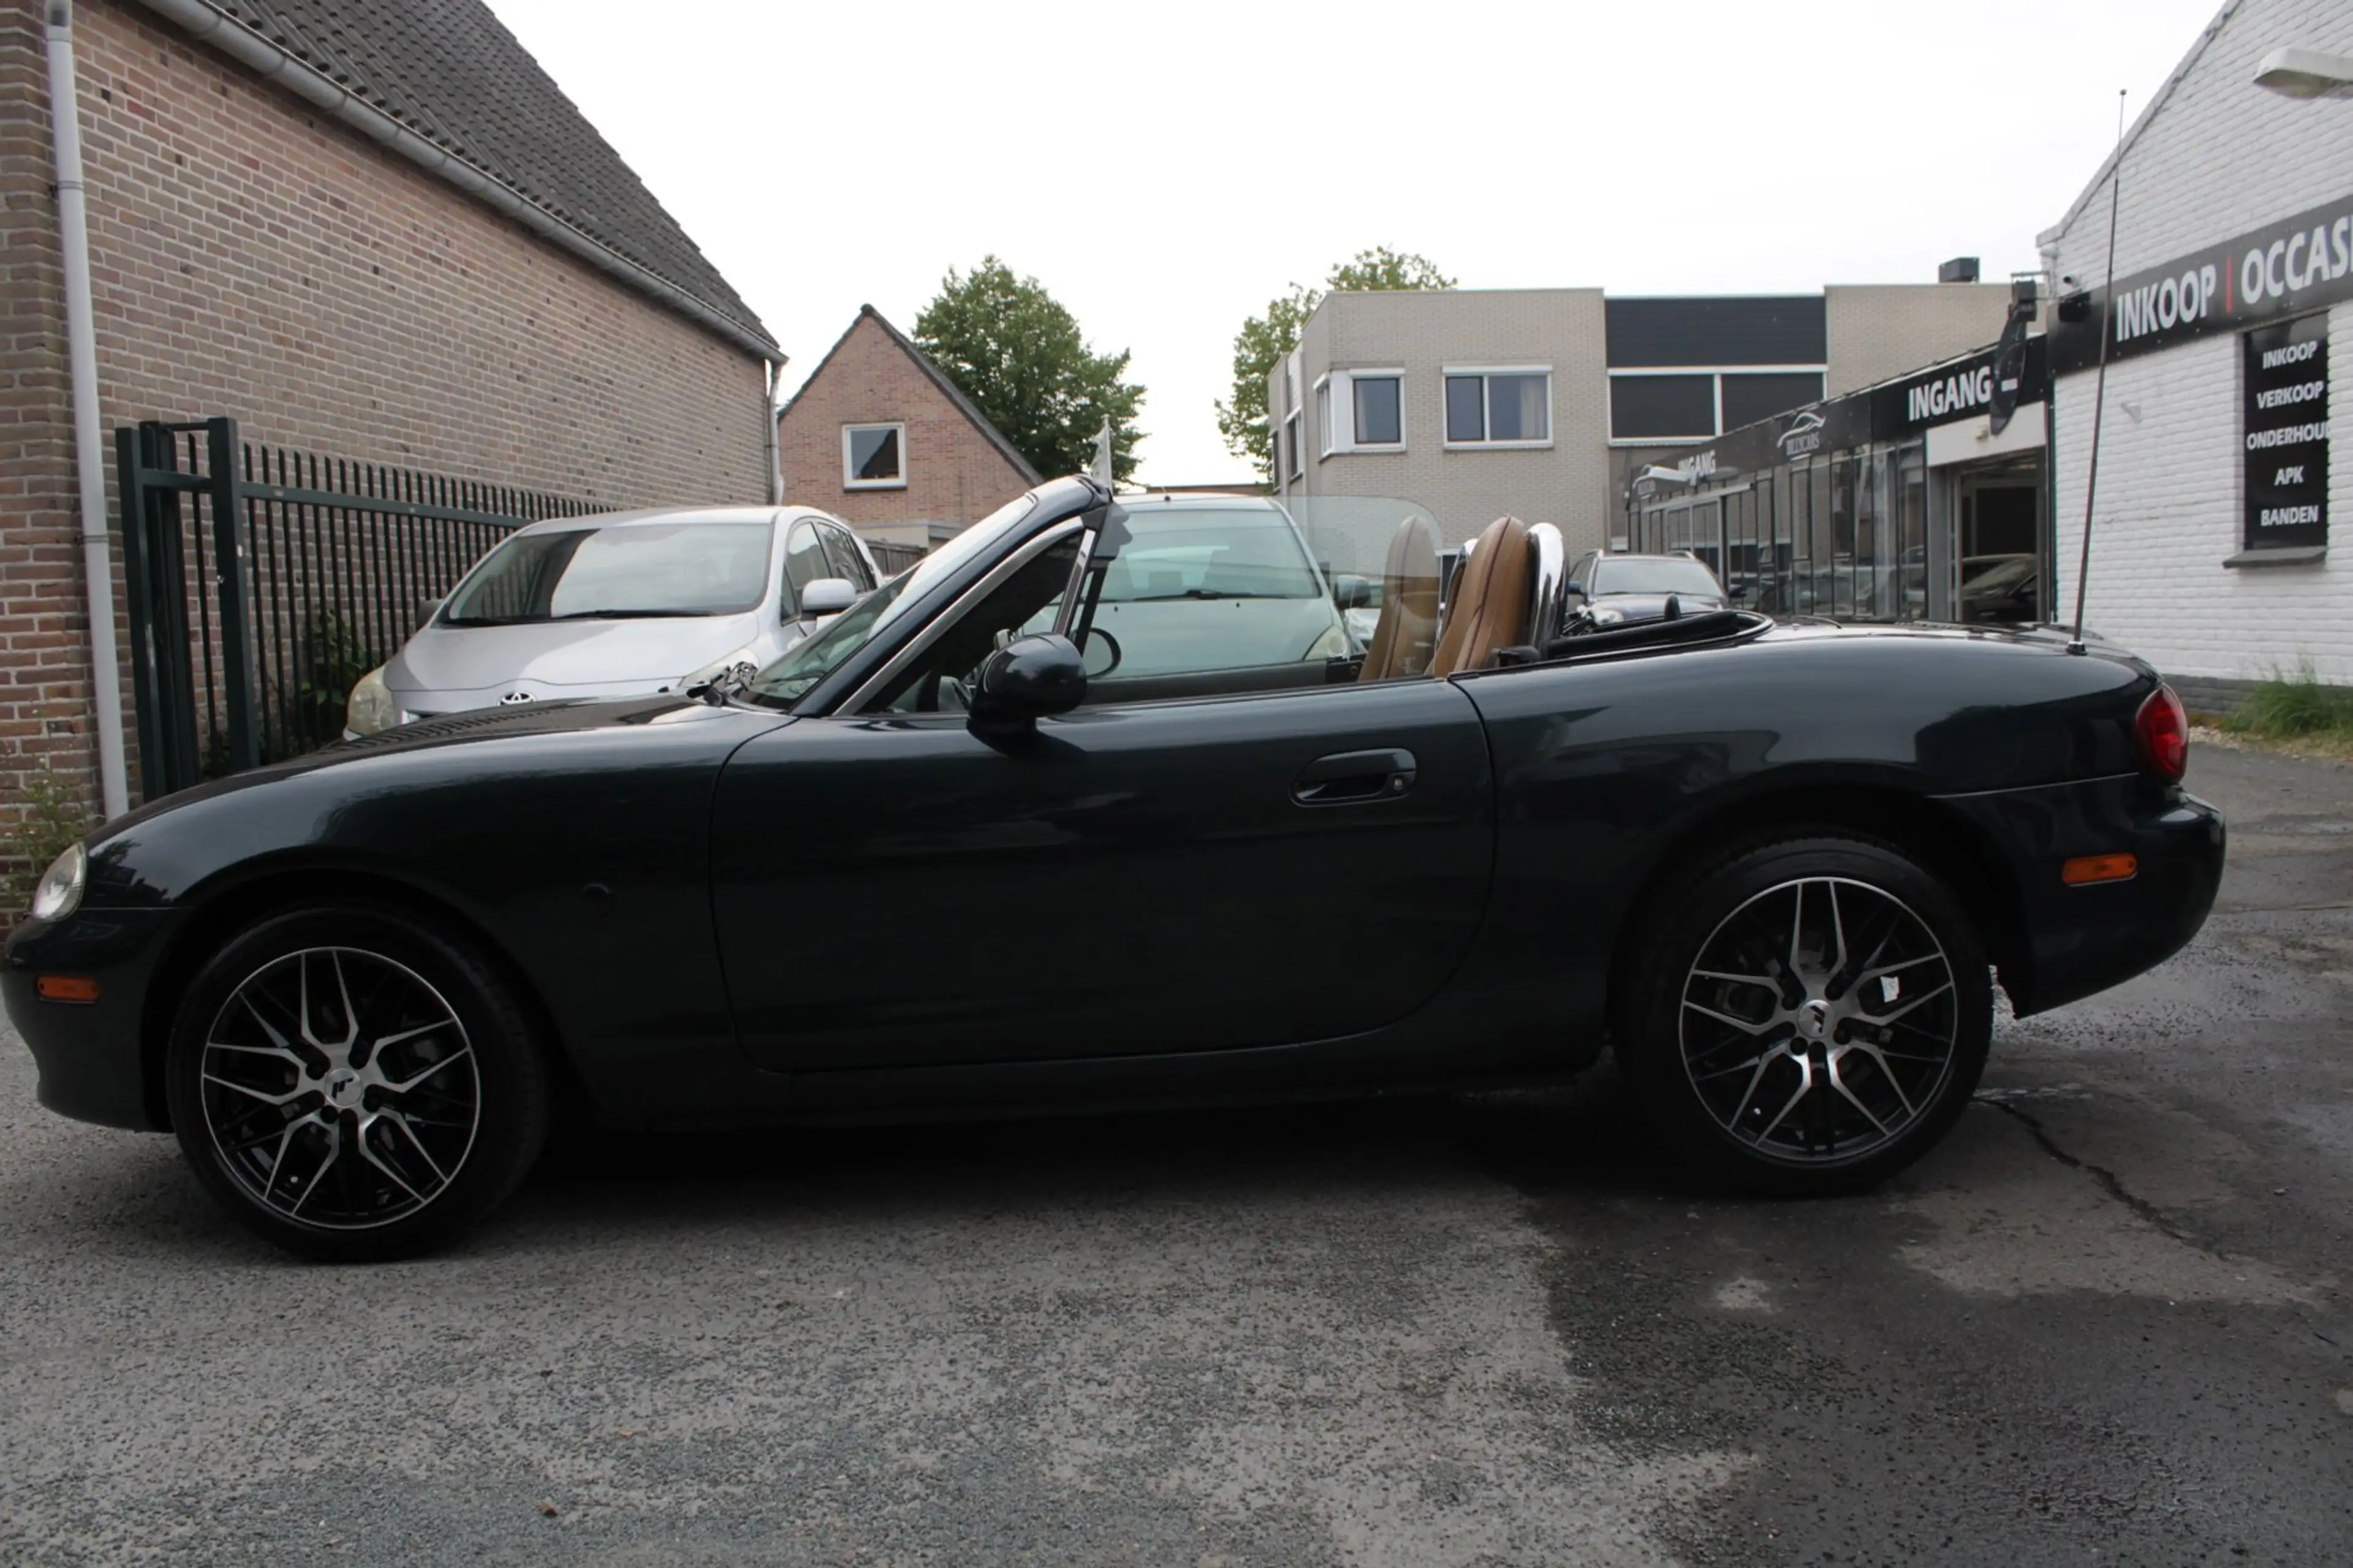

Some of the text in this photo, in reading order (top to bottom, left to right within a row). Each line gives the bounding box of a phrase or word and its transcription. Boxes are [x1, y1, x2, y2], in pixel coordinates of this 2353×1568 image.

[2116, 264, 2216, 343] INKOOP
[2262, 341, 2318, 370] INKOOP
[1908, 365, 1992, 422] INGANG
[2256, 381, 2324, 410] VERKOOP
[2274, 465, 2305, 486] APK
[2260, 504, 2319, 527] BANDEN
